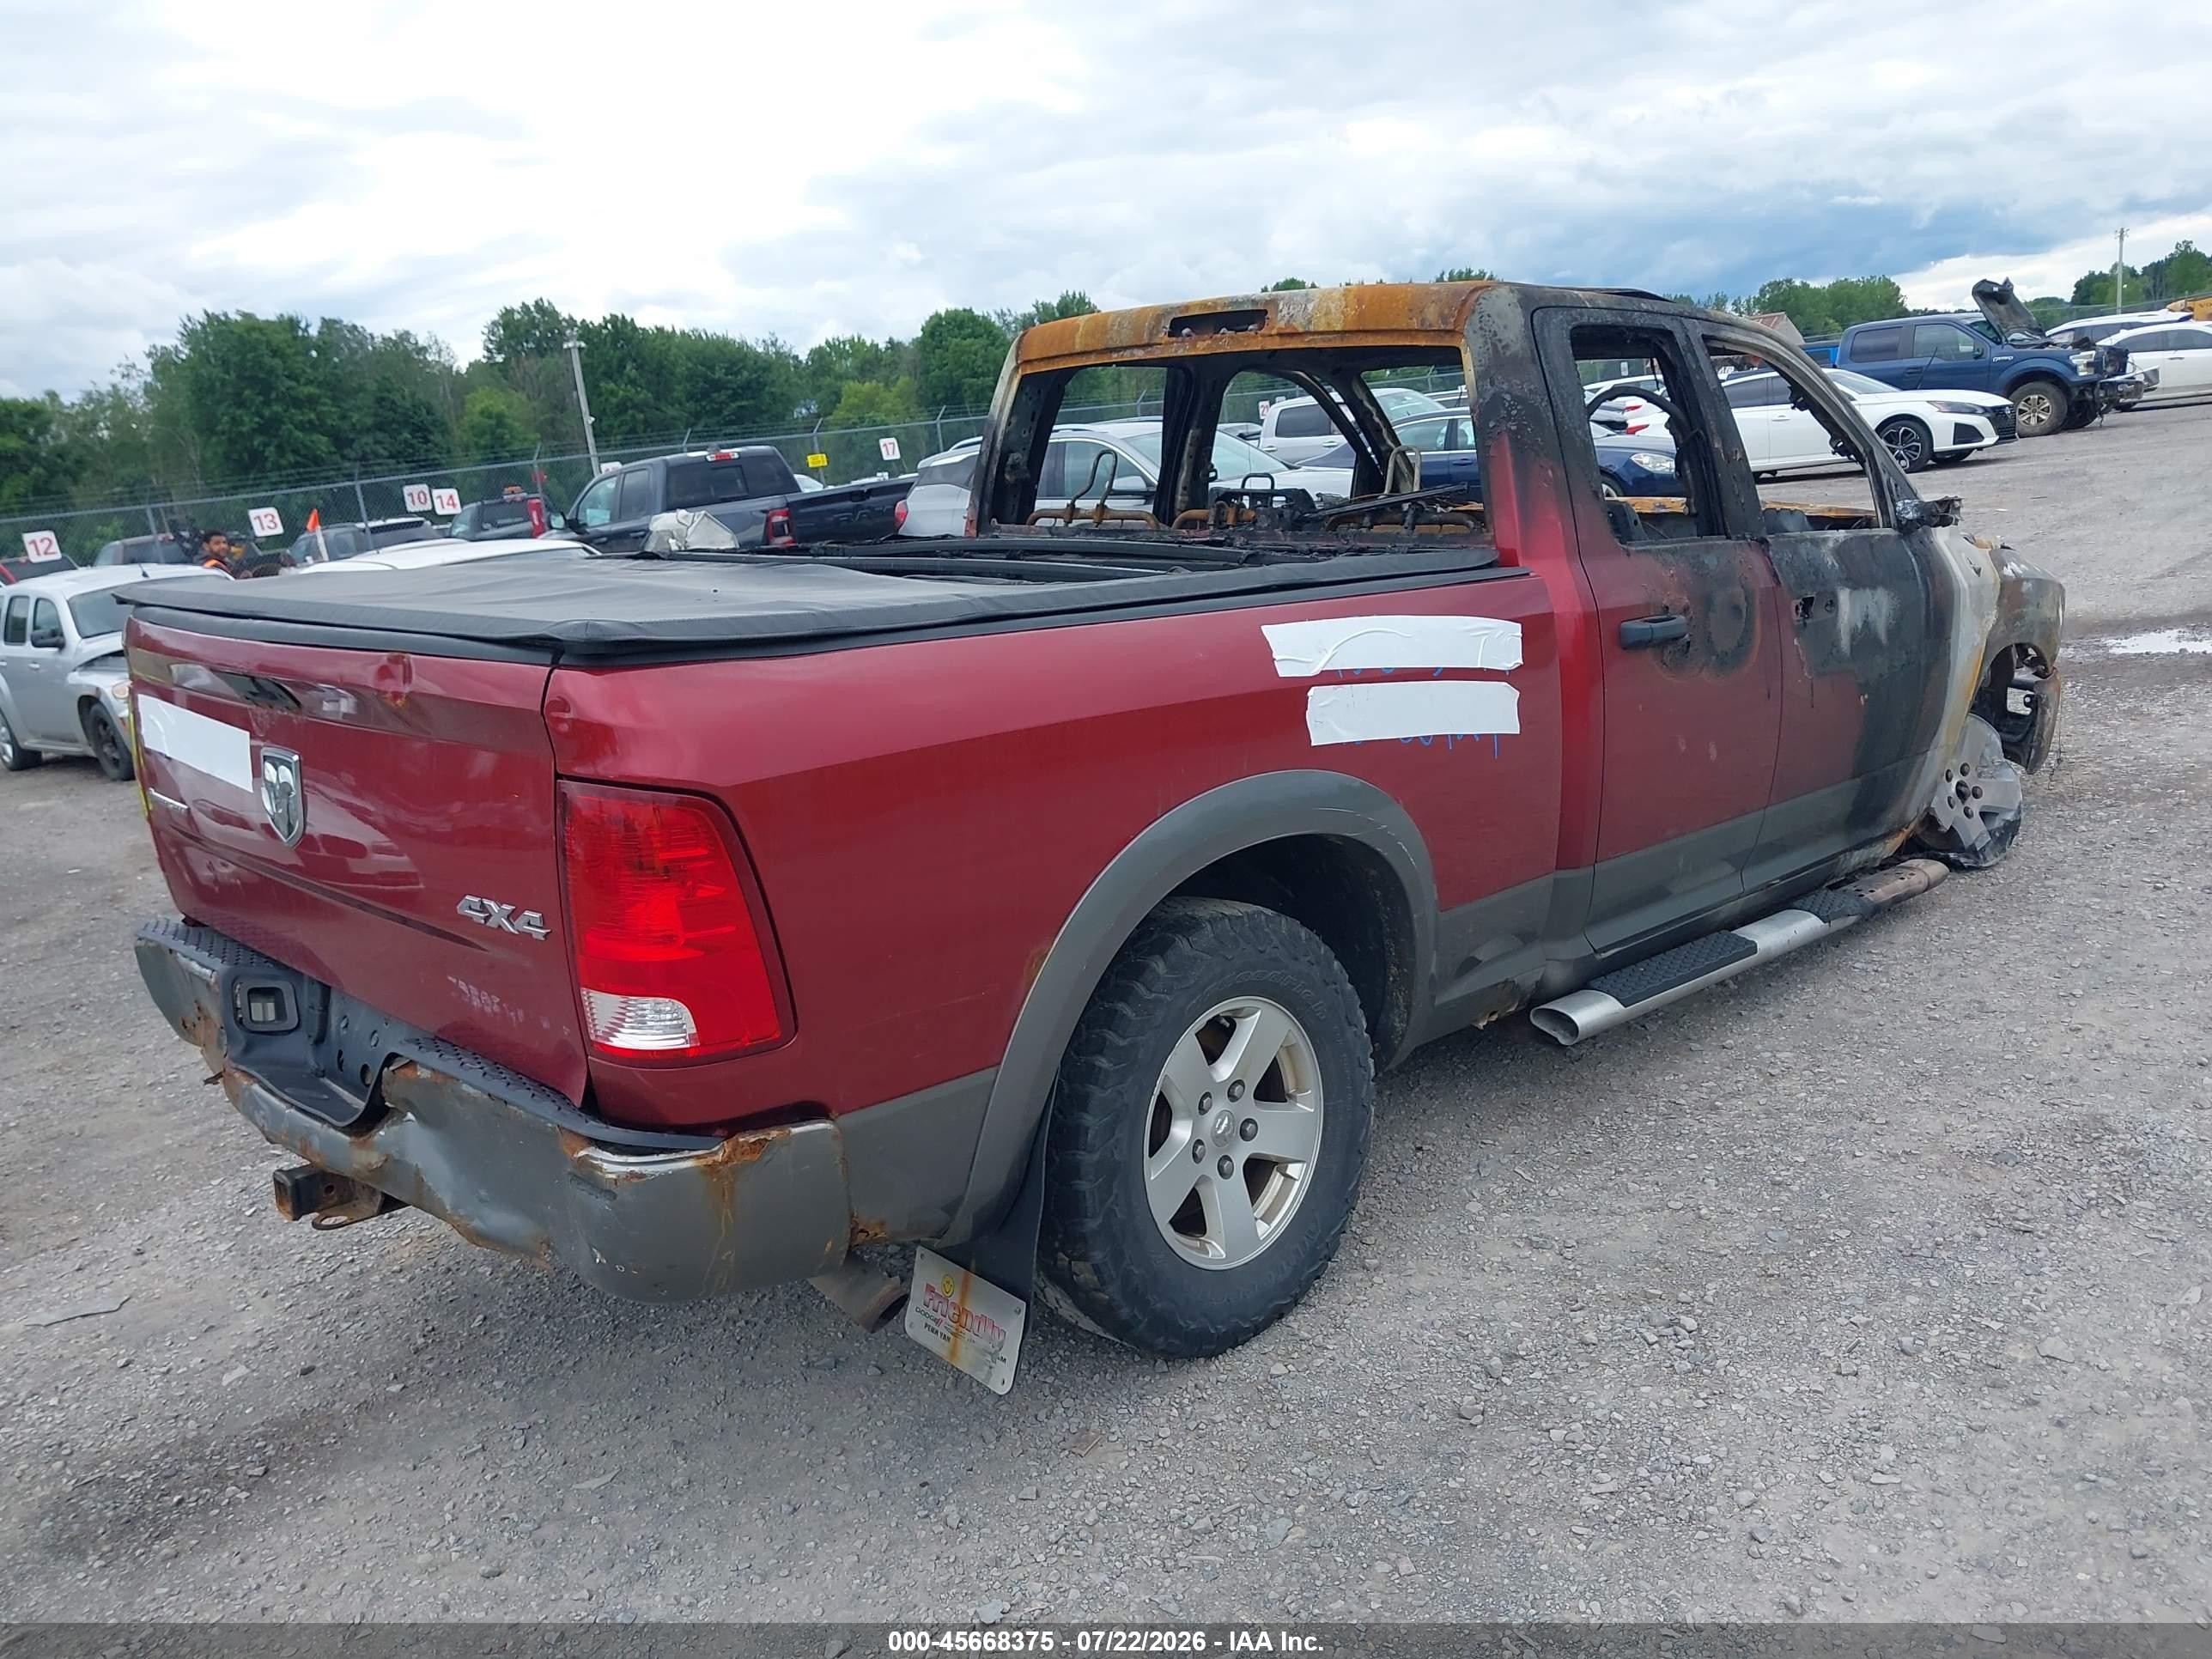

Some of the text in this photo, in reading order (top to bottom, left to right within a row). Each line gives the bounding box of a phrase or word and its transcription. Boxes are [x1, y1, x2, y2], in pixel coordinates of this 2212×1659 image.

[883, 441, 896, 456] 17
[407, 489, 428, 506] 10
[436, 494, 458, 509] 14
[253, 513, 278, 531] 13
[28, 537, 58, 556] 12
